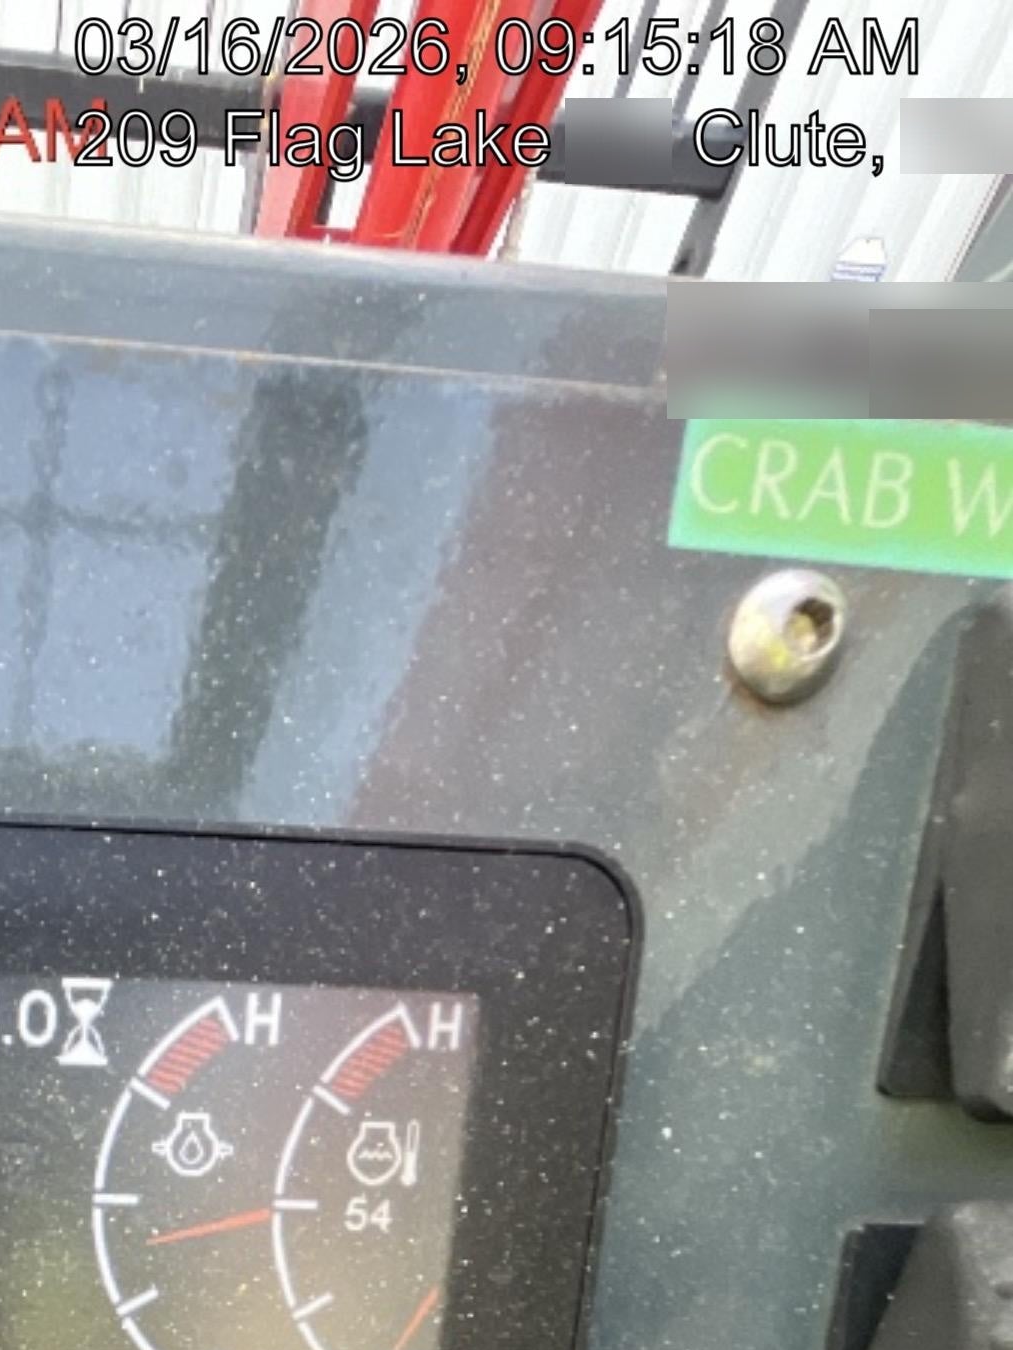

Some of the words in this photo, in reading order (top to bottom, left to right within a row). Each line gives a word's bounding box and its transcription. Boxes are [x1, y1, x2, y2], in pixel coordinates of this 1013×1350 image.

[690, 431, 914, 530] CRAB
[244, 993, 282, 1046] H
[428, 1003, 463, 1050] H
[345, 1200, 392, 1232] 54
